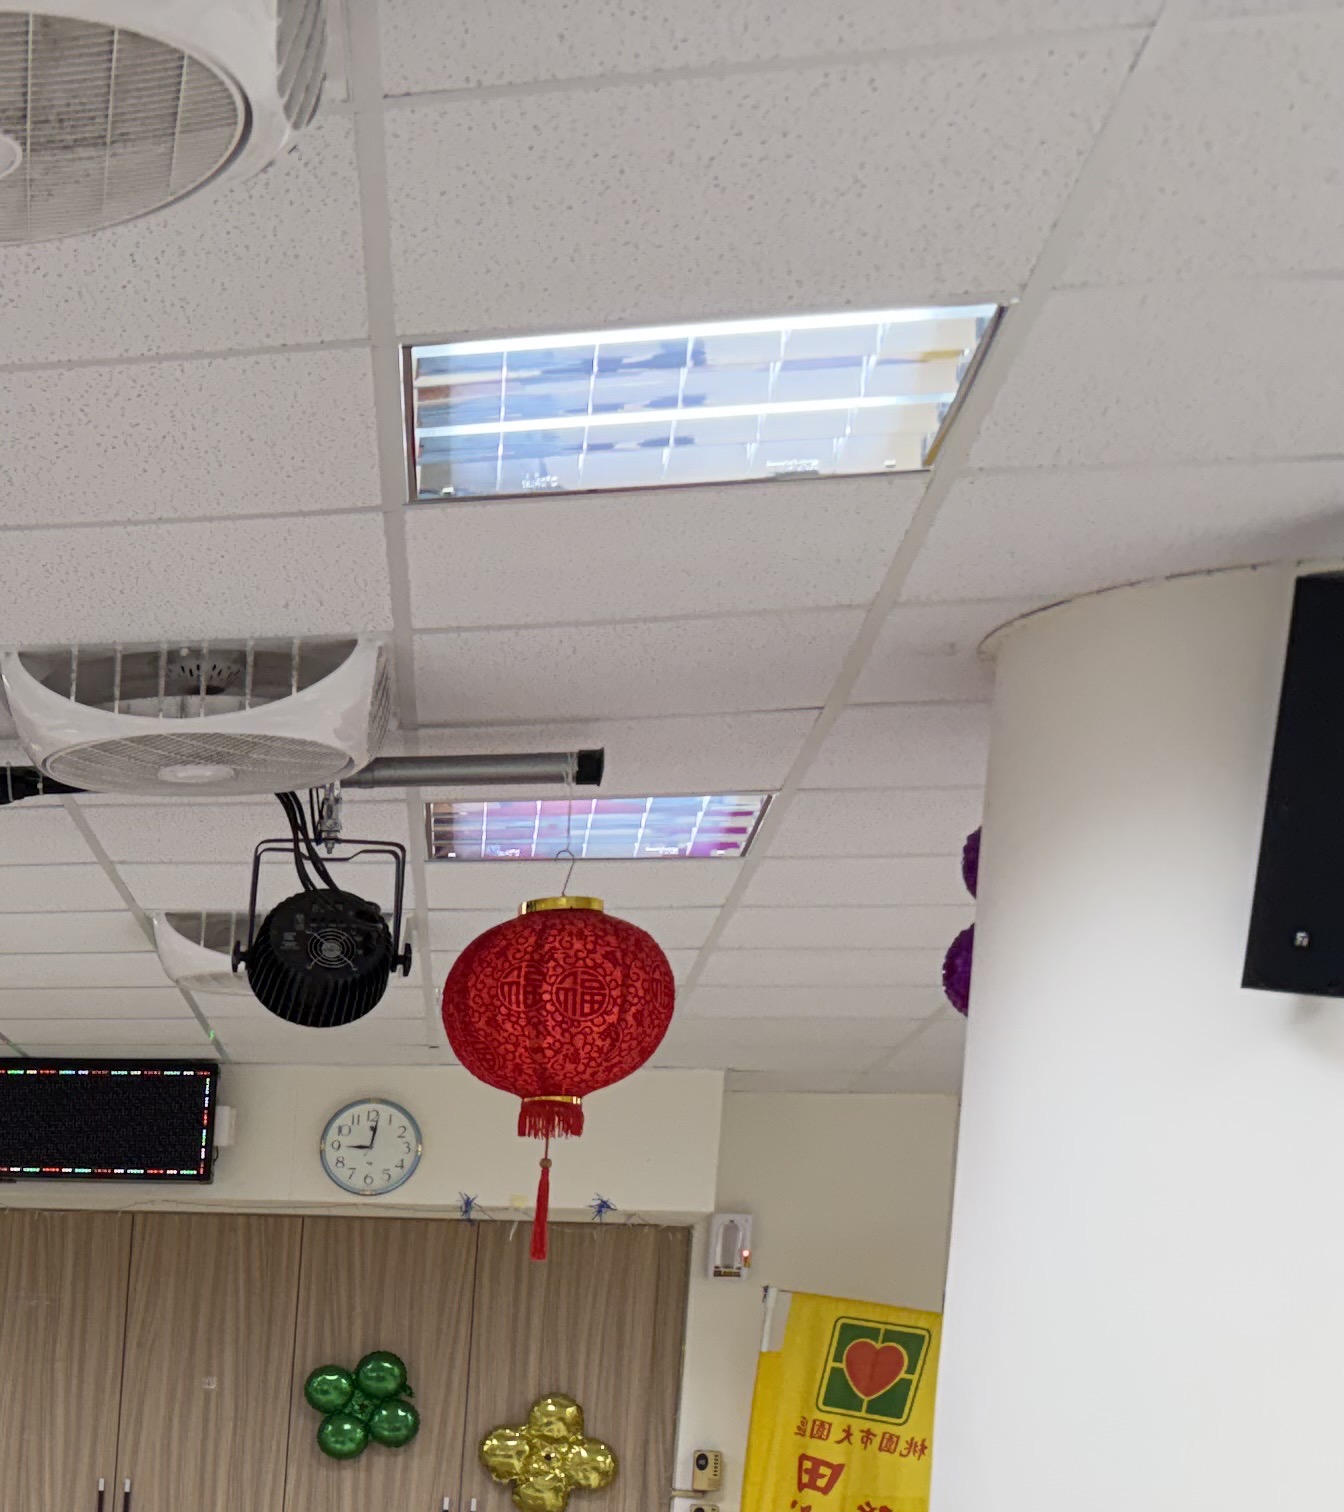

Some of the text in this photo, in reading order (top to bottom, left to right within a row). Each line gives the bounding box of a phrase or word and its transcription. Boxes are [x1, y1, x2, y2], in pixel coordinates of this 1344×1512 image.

[337, 1124, 352, 1137] 10
[396, 1126, 408, 1139] 2
[331, 1139, 342, 1152] 9
[402, 1141, 412, 1155] 3
[335, 1156, 346, 1169] 8
[394, 1158, 405, 1170] 4
[347, 1167, 357, 1180] 7
[363, 1173, 374, 1186] 6
[382, 1168, 392, 1182] 5
